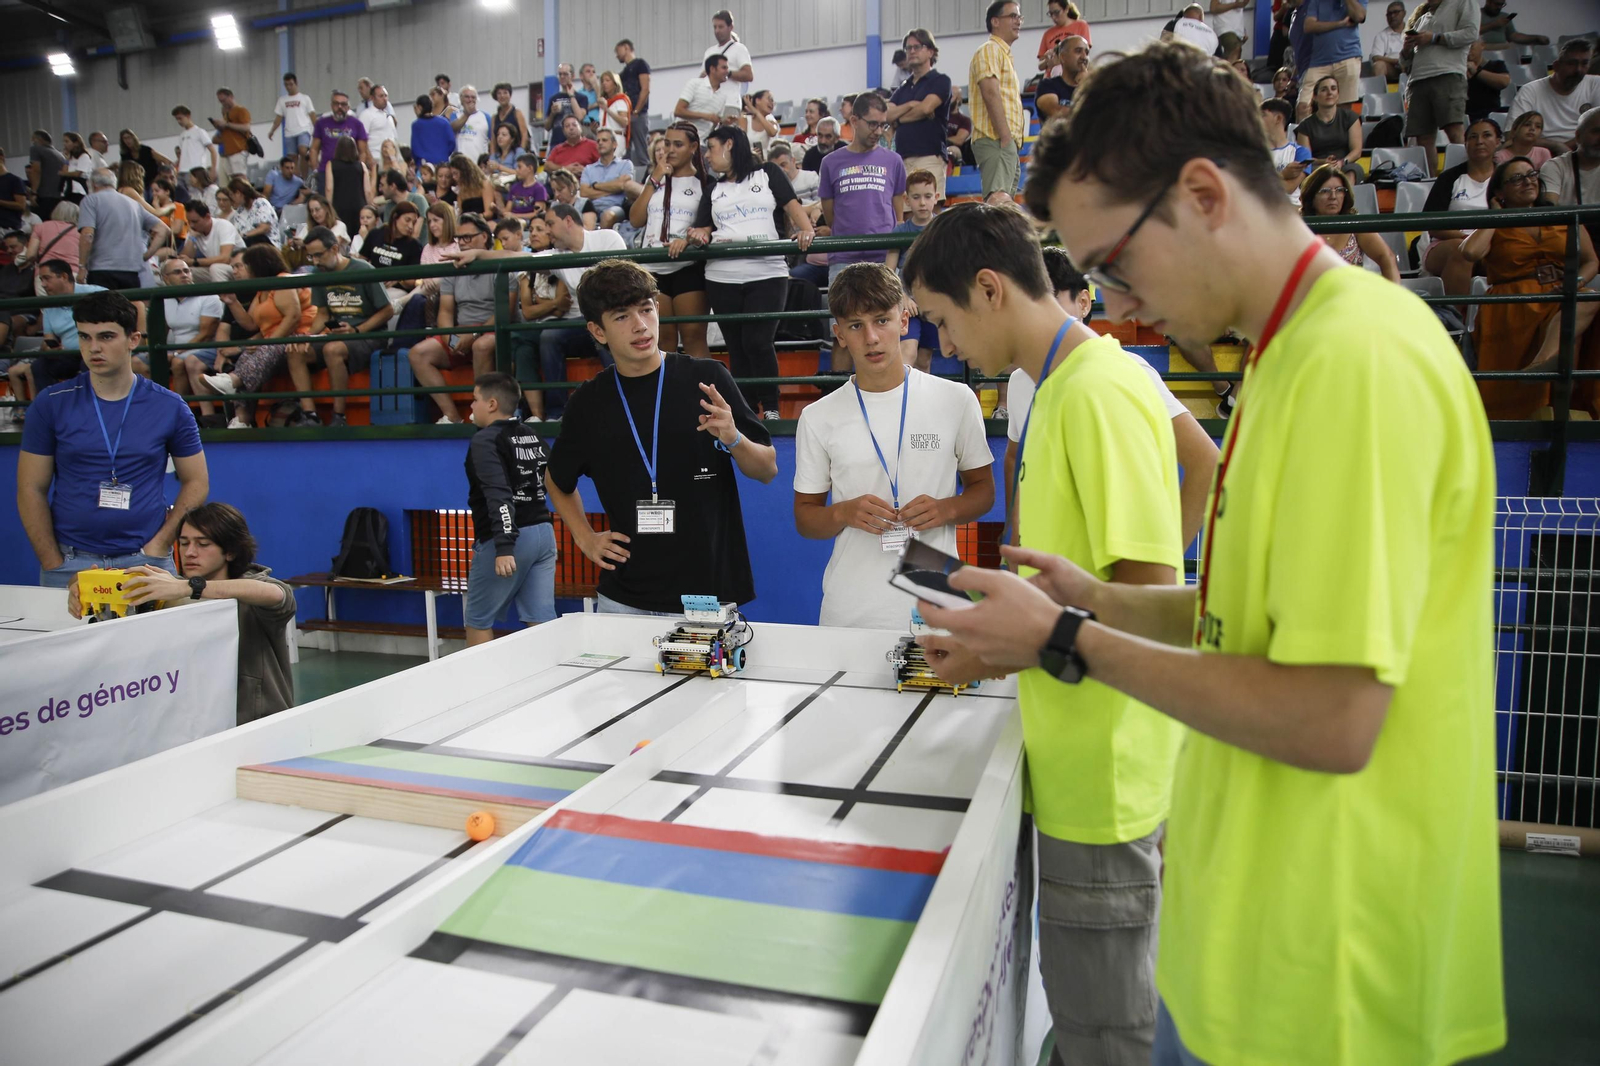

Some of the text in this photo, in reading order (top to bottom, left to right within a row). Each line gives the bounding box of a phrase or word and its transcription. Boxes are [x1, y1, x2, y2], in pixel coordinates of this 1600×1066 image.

[910, 433, 940, 441] RIPCURL
[911, 441, 928, 449] SURF
[93, 585, 112, 594] e-bot
[37, 698, 71, 724] de
[77, 675, 162, 719] género
[166, 669, 180, 694] y
